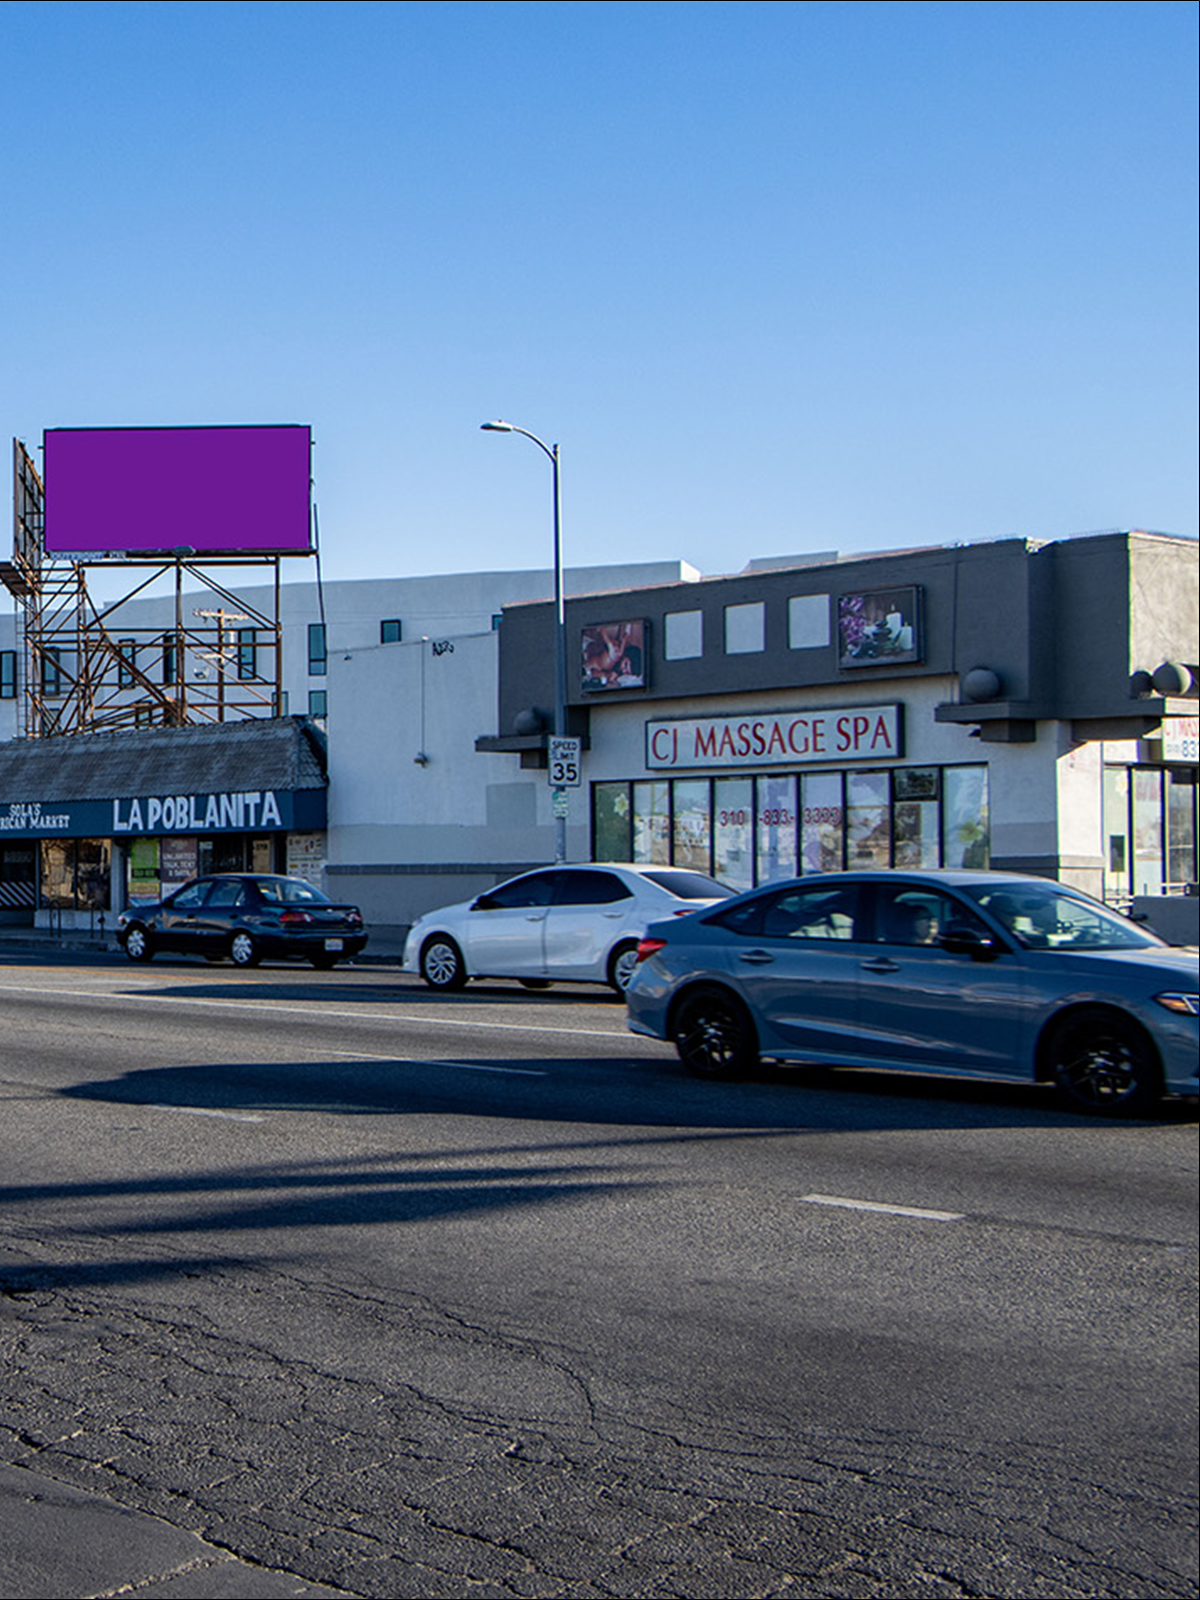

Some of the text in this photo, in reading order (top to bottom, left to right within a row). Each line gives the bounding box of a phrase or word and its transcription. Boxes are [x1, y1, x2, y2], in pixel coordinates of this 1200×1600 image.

[552, 740, 577, 751] SPEED
[651, 715, 892, 764] CJ MASSAGE SPA
[1181, 740, 1198, 757] 83
[553, 762, 577, 782] 35
[113, 791, 282, 831] LA POBLANITA
[719, 809, 746, 827] 310
[803, 806, 841, 824] 3333
[28, 815, 71, 830] MARKET
